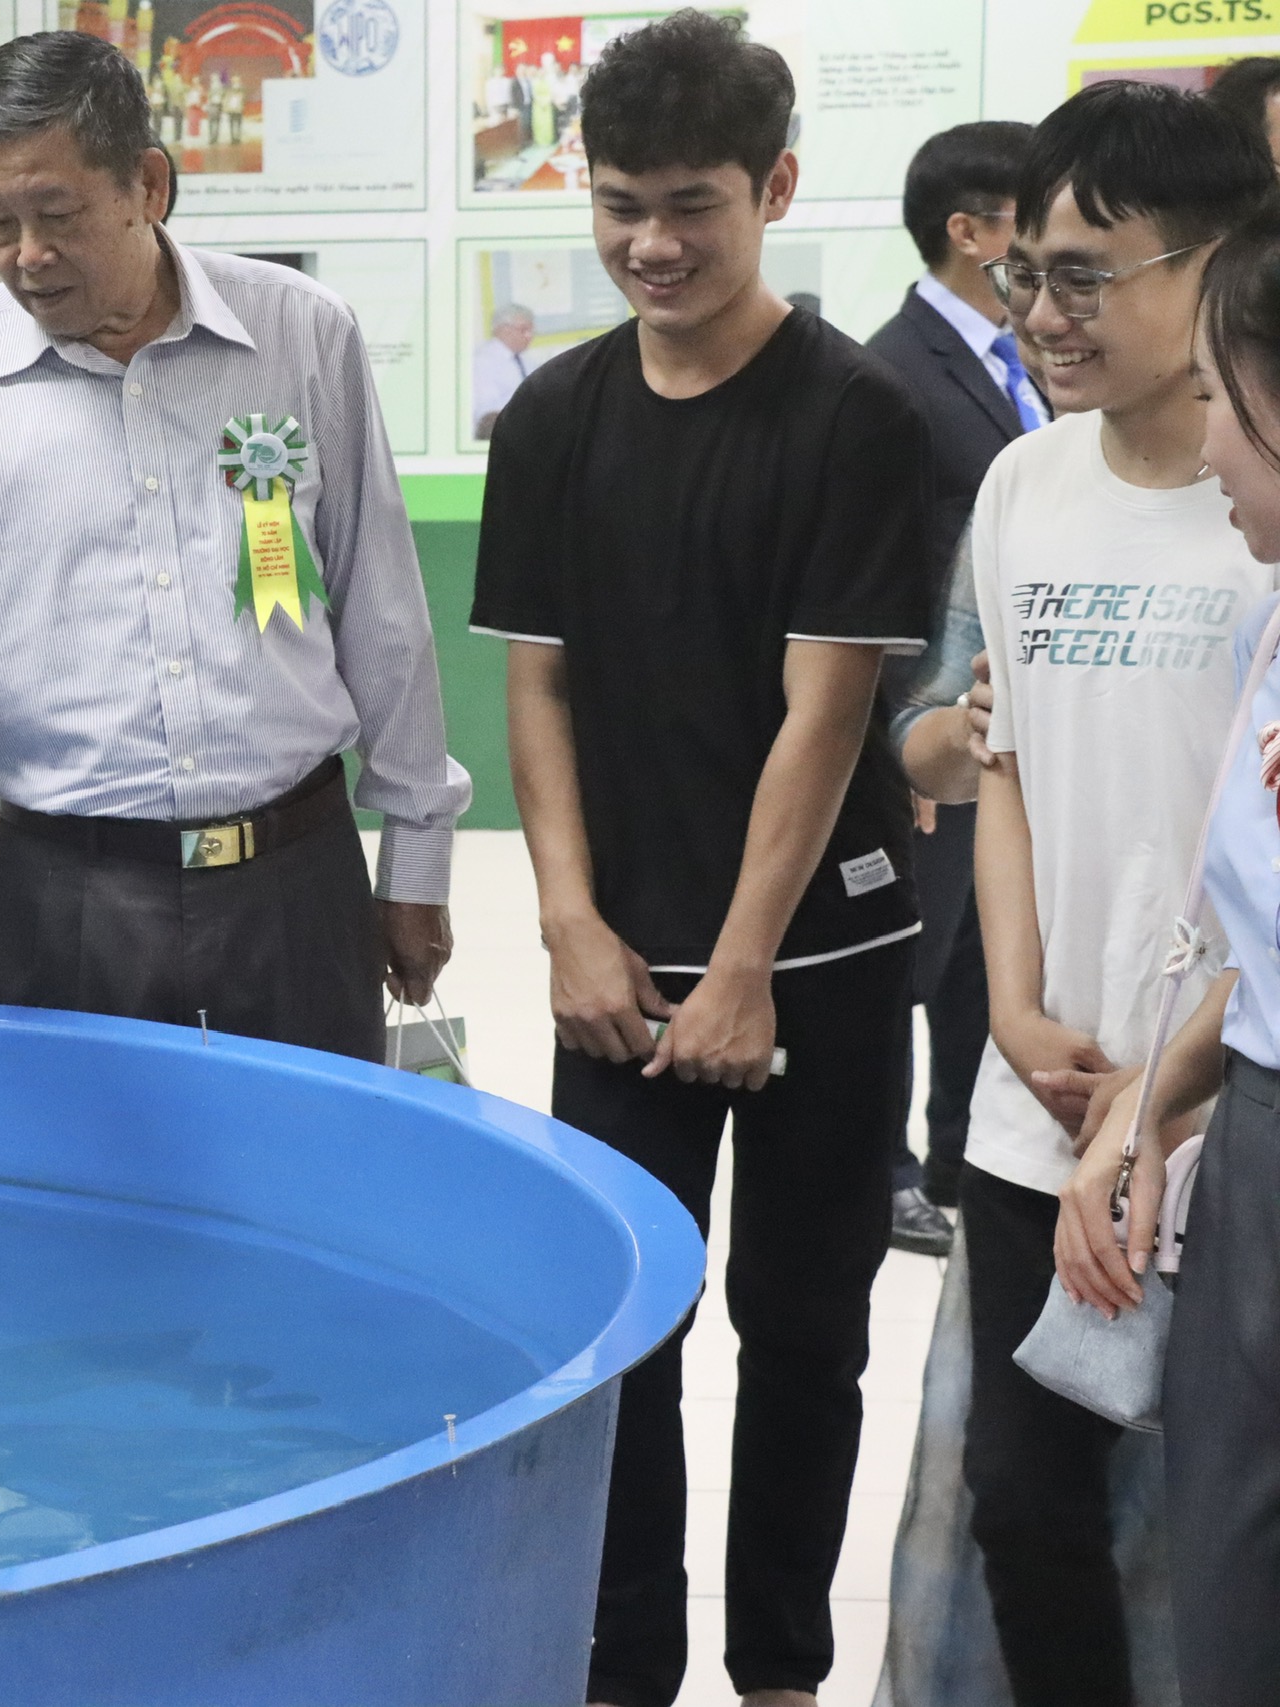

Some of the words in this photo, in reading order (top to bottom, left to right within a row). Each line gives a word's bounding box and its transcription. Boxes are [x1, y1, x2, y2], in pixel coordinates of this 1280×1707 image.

[1146, 0, 1271, 25] PGS.TS.
[1012, 583, 1140, 621] THERE
[1017, 629, 1119, 667] SPEED
